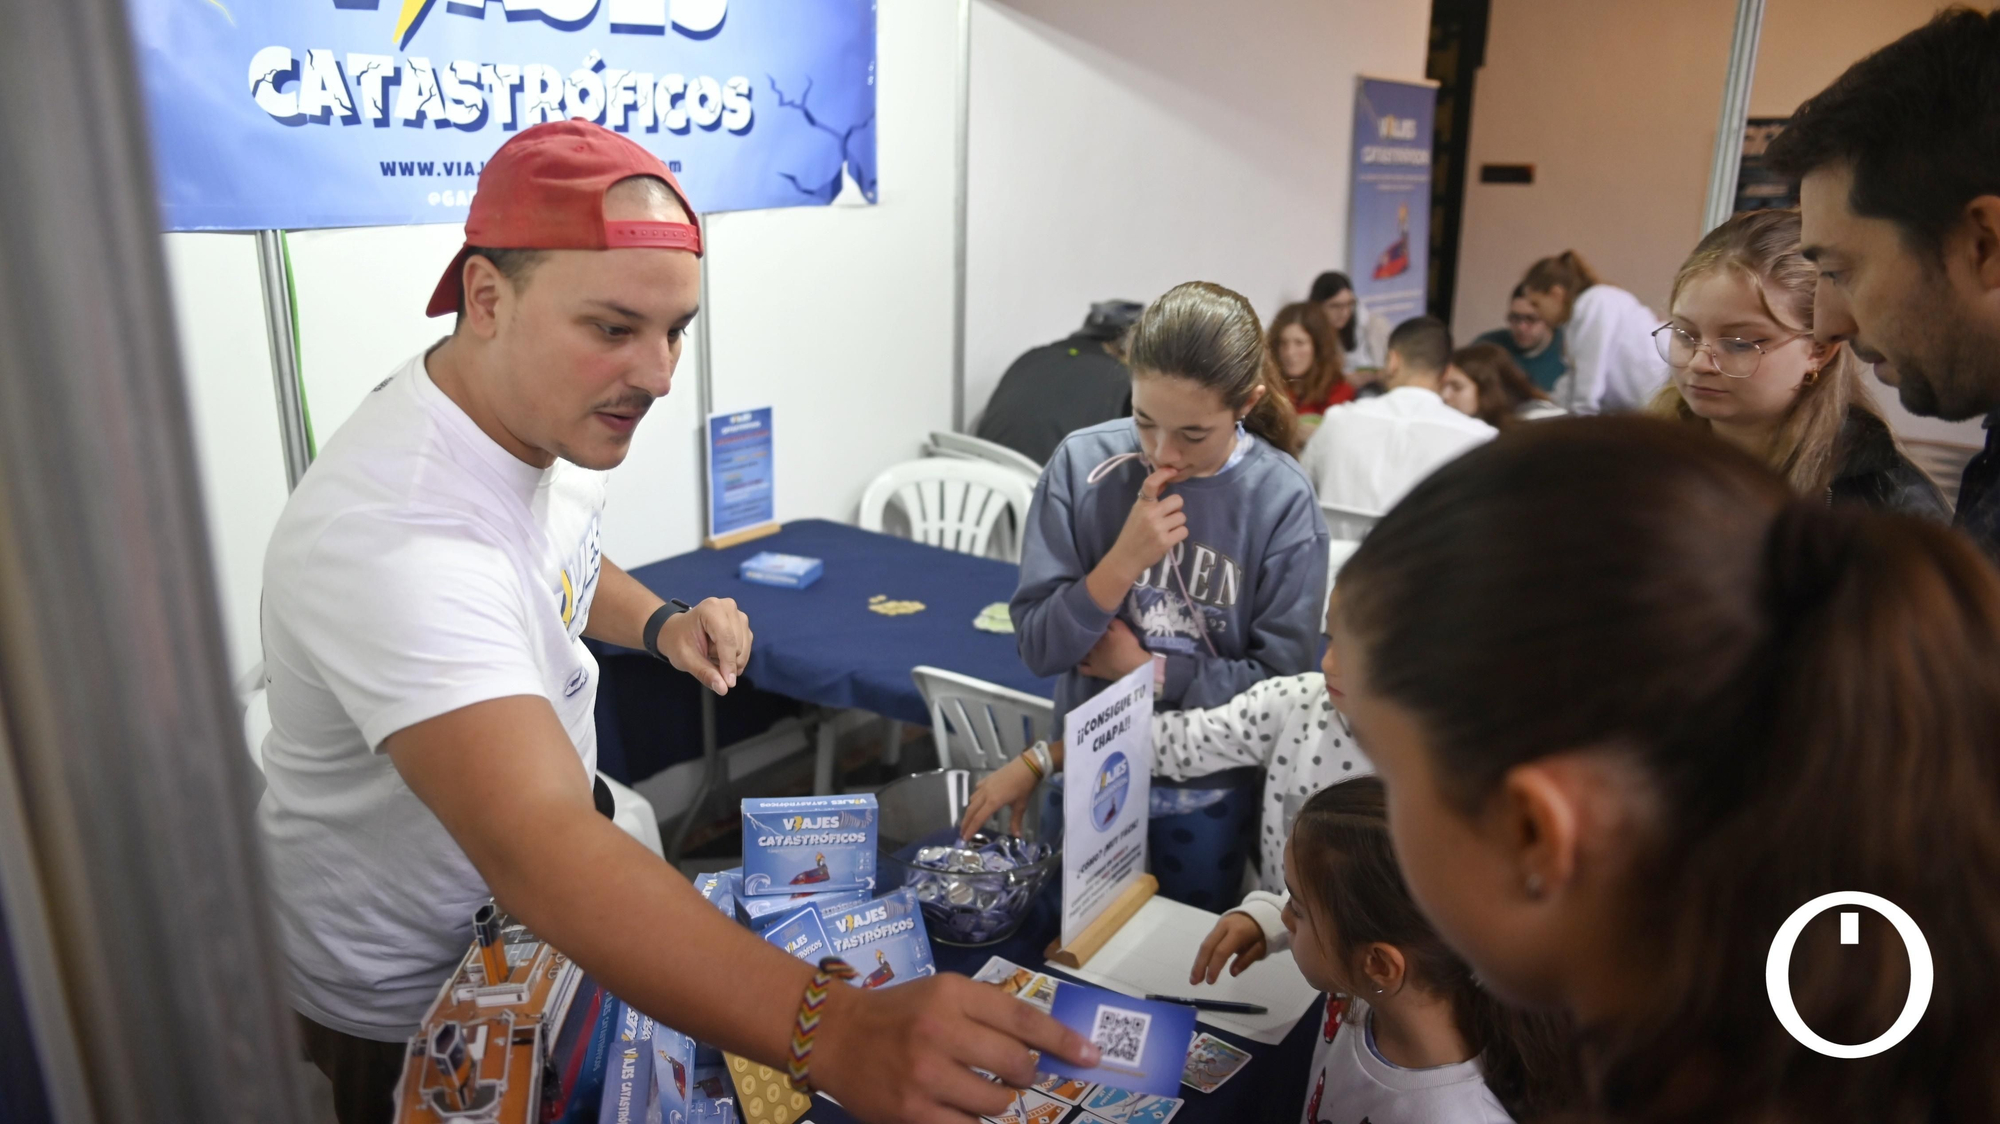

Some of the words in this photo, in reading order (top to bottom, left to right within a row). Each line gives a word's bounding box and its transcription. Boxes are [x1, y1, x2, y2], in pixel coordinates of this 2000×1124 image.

[248, 46, 754, 134] CATASTRÓFICOS
[1134, 684, 1146, 701] TU
[1093, 715, 1131, 752] CHAPA!!
[758, 831, 866, 847] CATASTRÓFICOS
[783, 815, 839, 833] VIAJES
[835, 906, 887, 934] VIAJES
[785, 934, 807, 954] VIAJES
[834, 918, 914, 953] TASTRÓFICOS
[621, 1047, 639, 1080] VIAJES
[617, 1082, 632, 1124] CATASTRÓ
